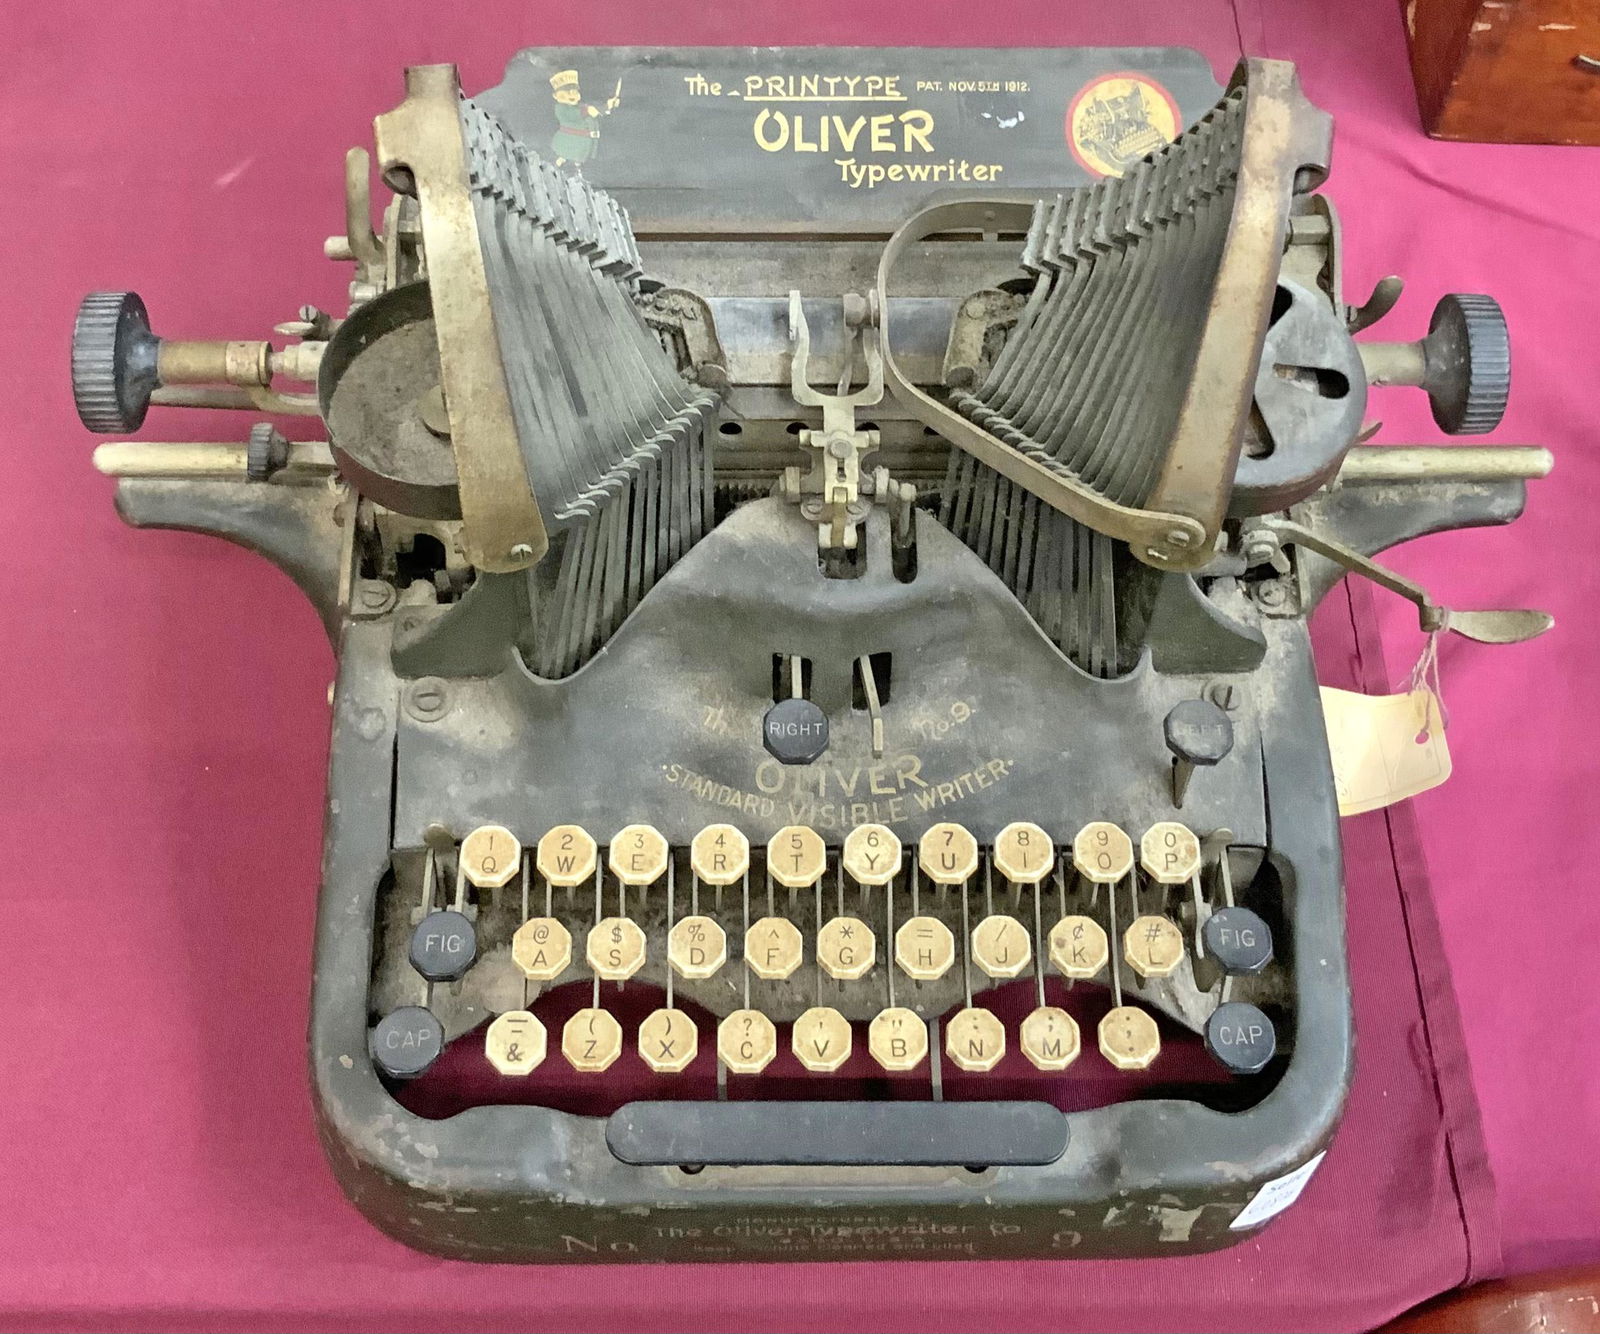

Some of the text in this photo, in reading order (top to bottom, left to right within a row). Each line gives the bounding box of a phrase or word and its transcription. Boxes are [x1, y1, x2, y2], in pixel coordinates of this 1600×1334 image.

[685, 73, 902, 98] The PRINTYPE
[916, 80, 943, 92] PAT.
[1004, 80, 1031, 92] 1912.
[753, 107, 935, 153] OLIVER
[834, 158, 1003, 189] Typewriter
[769, 721, 823, 737] RIGHT
[665, 762, 775, 818] STANDARD
[788, 797, 908, 829] VISIBLE
[560, 833, 574, 851] 2
[634, 833, 645, 849] 3
[714, 833, 727, 849] 4
[791, 833, 803, 850] 5
[866, 830, 879, 848] 6
[942, 830, 954, 847] 7
[1017, 830, 1030, 847] 8
[1096, 830, 1109, 847] 9
[481, 855, 499, 874] Q
[556, 855, 576, 873] W
[631, 853, 645, 872] E
[713, 853, 727, 871] R
[789, 852, 804, 873] T
[864, 852, 880, 871] Y
[941, 852, 956, 871] U
[1164, 852, 1179, 871] P
[532, 924, 550, 945] @
[611, 923, 623, 945] $
[687, 923, 706, 943] %
[995, 923, 1008, 943] /
[1144, 922, 1162, 943] #
[1220, 929, 1255, 947] FIG
[424, 934, 462, 952] FIG
[531, 949, 548, 967] A
[608, 948, 622, 968] S
[690, 947, 706, 966] D
[766, 947, 780, 967] F
[838, 946, 854, 965] G
[918, 948, 933, 967] H
[995, 946, 1008, 965] J
[1072, 946, 1087, 964] K
[1148, 948, 1164, 966] L
[589, 1015, 596, 1036] (
[665, 1015, 672, 1036] )
[743, 1017, 753, 1037] ?
[387, 1029, 431, 1048] CAP
[1220, 1027, 1262, 1045] CAP
[506, 1042, 523, 1062] &
[583, 1039, 597, 1060] Z
[658, 1039, 675, 1059] X
[740, 1040, 753, 1060] C
[813, 1039, 830, 1058] V
[891, 1038, 907, 1058] B
[969, 1039, 984, 1058] N
[1042, 1038, 1063, 1058] M
